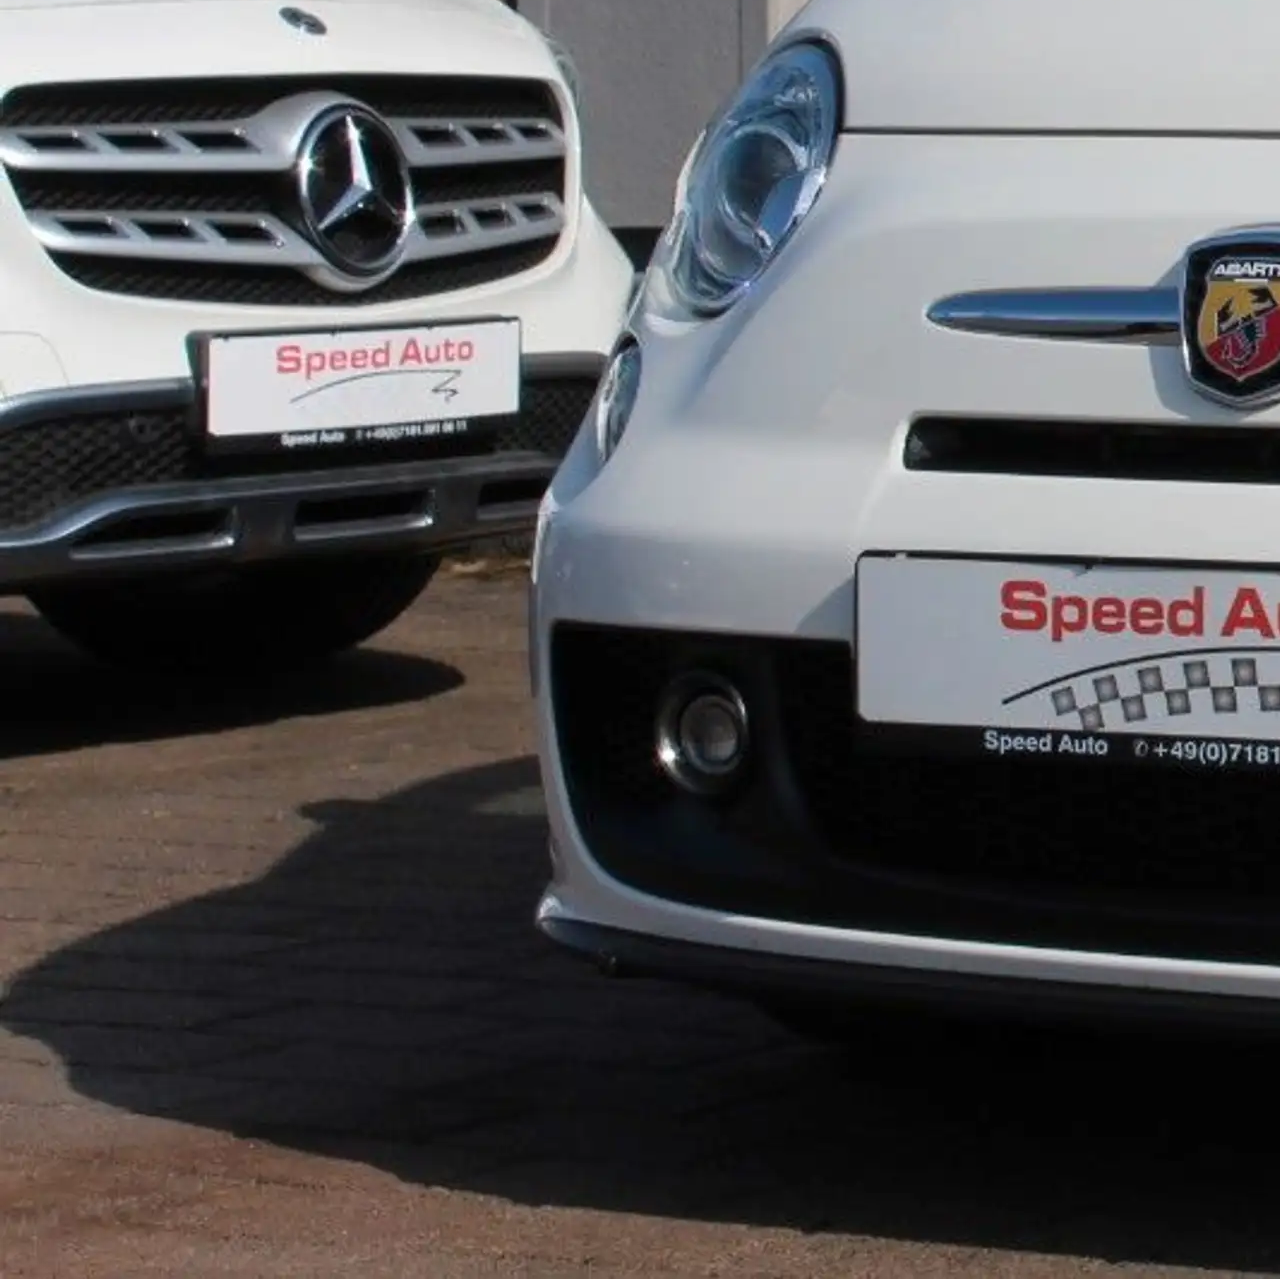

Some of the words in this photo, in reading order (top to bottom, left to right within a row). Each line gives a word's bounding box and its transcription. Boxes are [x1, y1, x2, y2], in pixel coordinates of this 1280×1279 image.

[275, 339, 392, 380] Speed
[399, 337, 475, 366] Auto
[1000, 579, 1206, 643] Speed
[983, 729, 1052, 755] Speed
[1057, 733, 1109, 756] Auto
